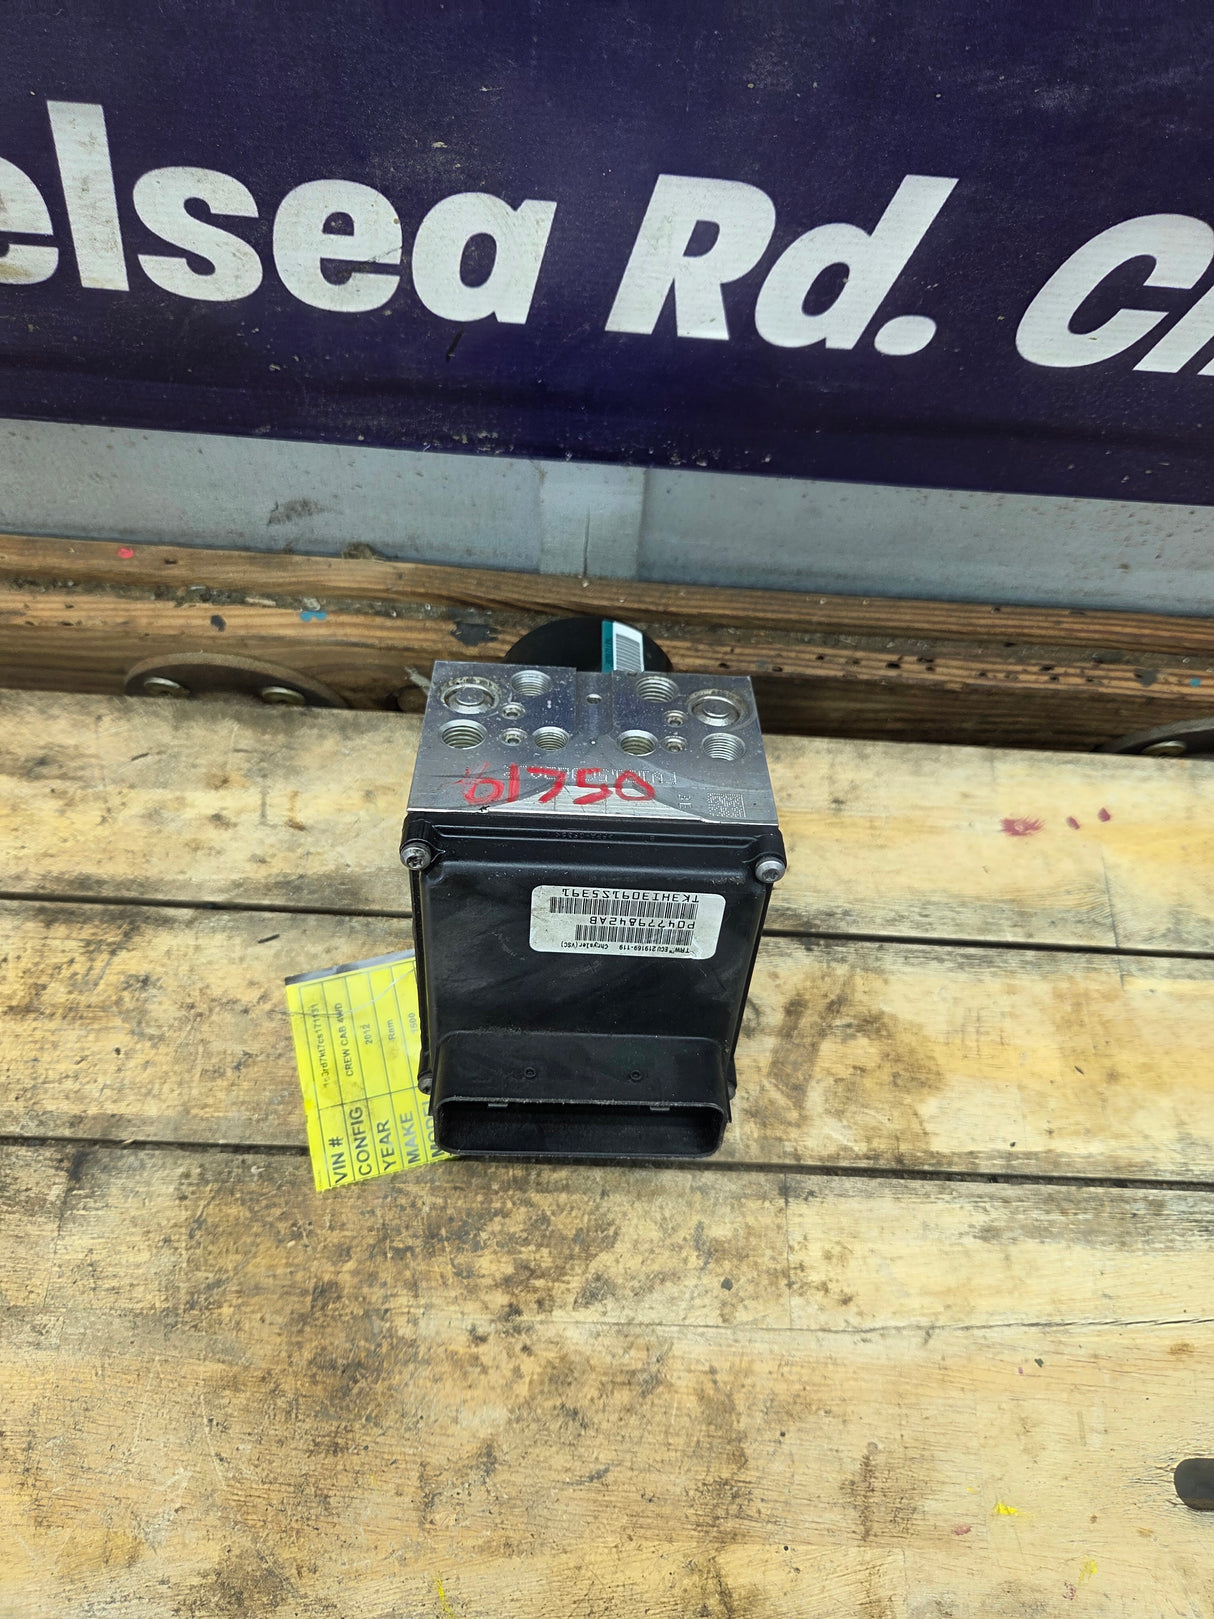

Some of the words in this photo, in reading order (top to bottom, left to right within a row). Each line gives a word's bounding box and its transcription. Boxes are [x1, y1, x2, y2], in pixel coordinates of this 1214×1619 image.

[604, 173, 960, 357] Rd.
[335, 1002, 345, 1023] 4WD
[339, 1025, 349, 1046] CAB
[360, 1024, 373, 1045] 2012
[383, 1019, 395, 1041] Ram
[342, 1049, 353, 1077] CREW
[329, 1136, 343, 1147] #
[351, 1106, 372, 1176] CONFIG
[377, 1120, 394, 1171] YEAR
[400, 1111, 421, 1169] MAKE
[331, 1153, 346, 1184] VIN
